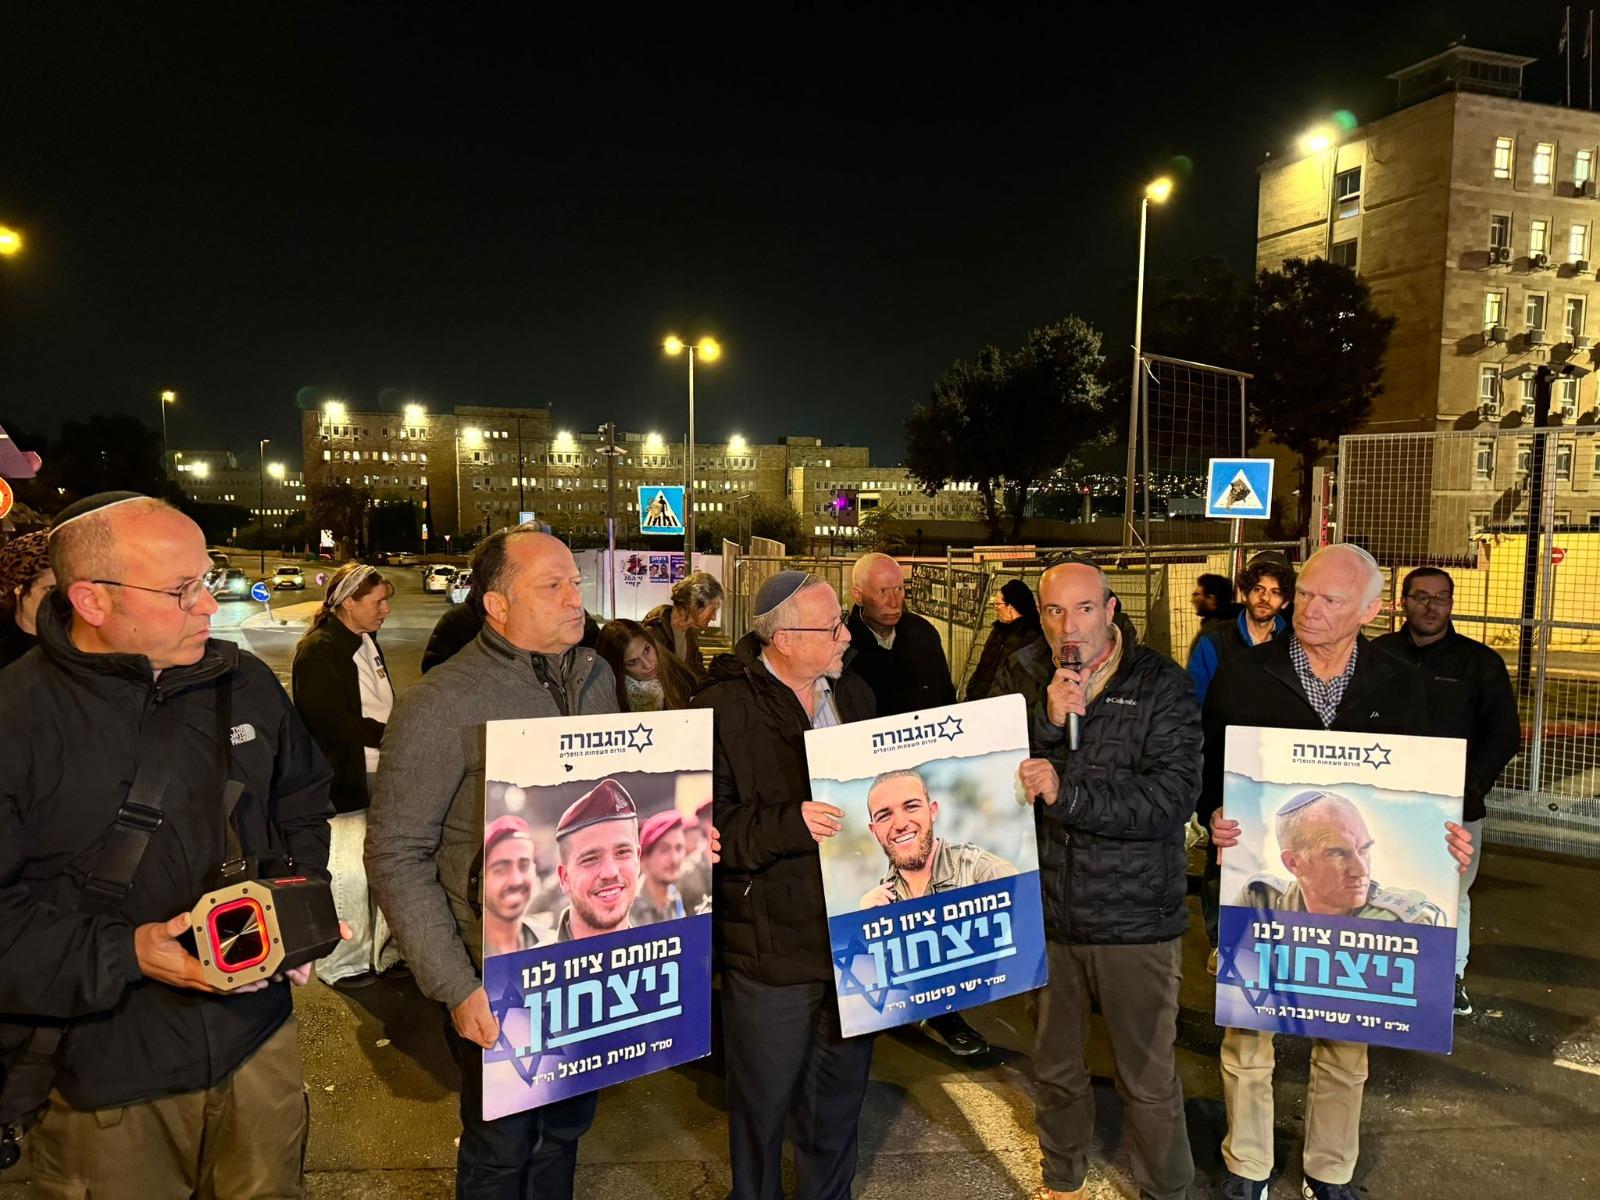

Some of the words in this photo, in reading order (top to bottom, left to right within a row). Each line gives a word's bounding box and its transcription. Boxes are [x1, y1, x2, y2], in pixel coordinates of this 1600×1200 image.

[560, 730, 626, 750] הגבורה
[873, 724, 936, 747] הגבורה
[1293, 744, 1360, 760] הגבורה
[943, 891, 1012, 921] במותם
[862, 916, 894, 940] לנו
[900, 908, 937, 932] ציוו
[1252, 920, 1285, 940] לנו
[1292, 925, 1332, 945] ציוו
[1339, 930, 1419, 955] במותם
[610, 936, 682, 969] במותם
[521, 960, 556, 989] לנו
[563, 953, 604, 979] ציוו
[909, 985, 956, 1005] פיטוסי
[959, 978, 982, 992] ישי
[1278, 1005, 1351, 1024] שטיינברג
[1356, 1014, 1381, 1027] יוני
[607, 1042, 646, 1065] עמית
[558, 1055, 602, 1079] בונצל
